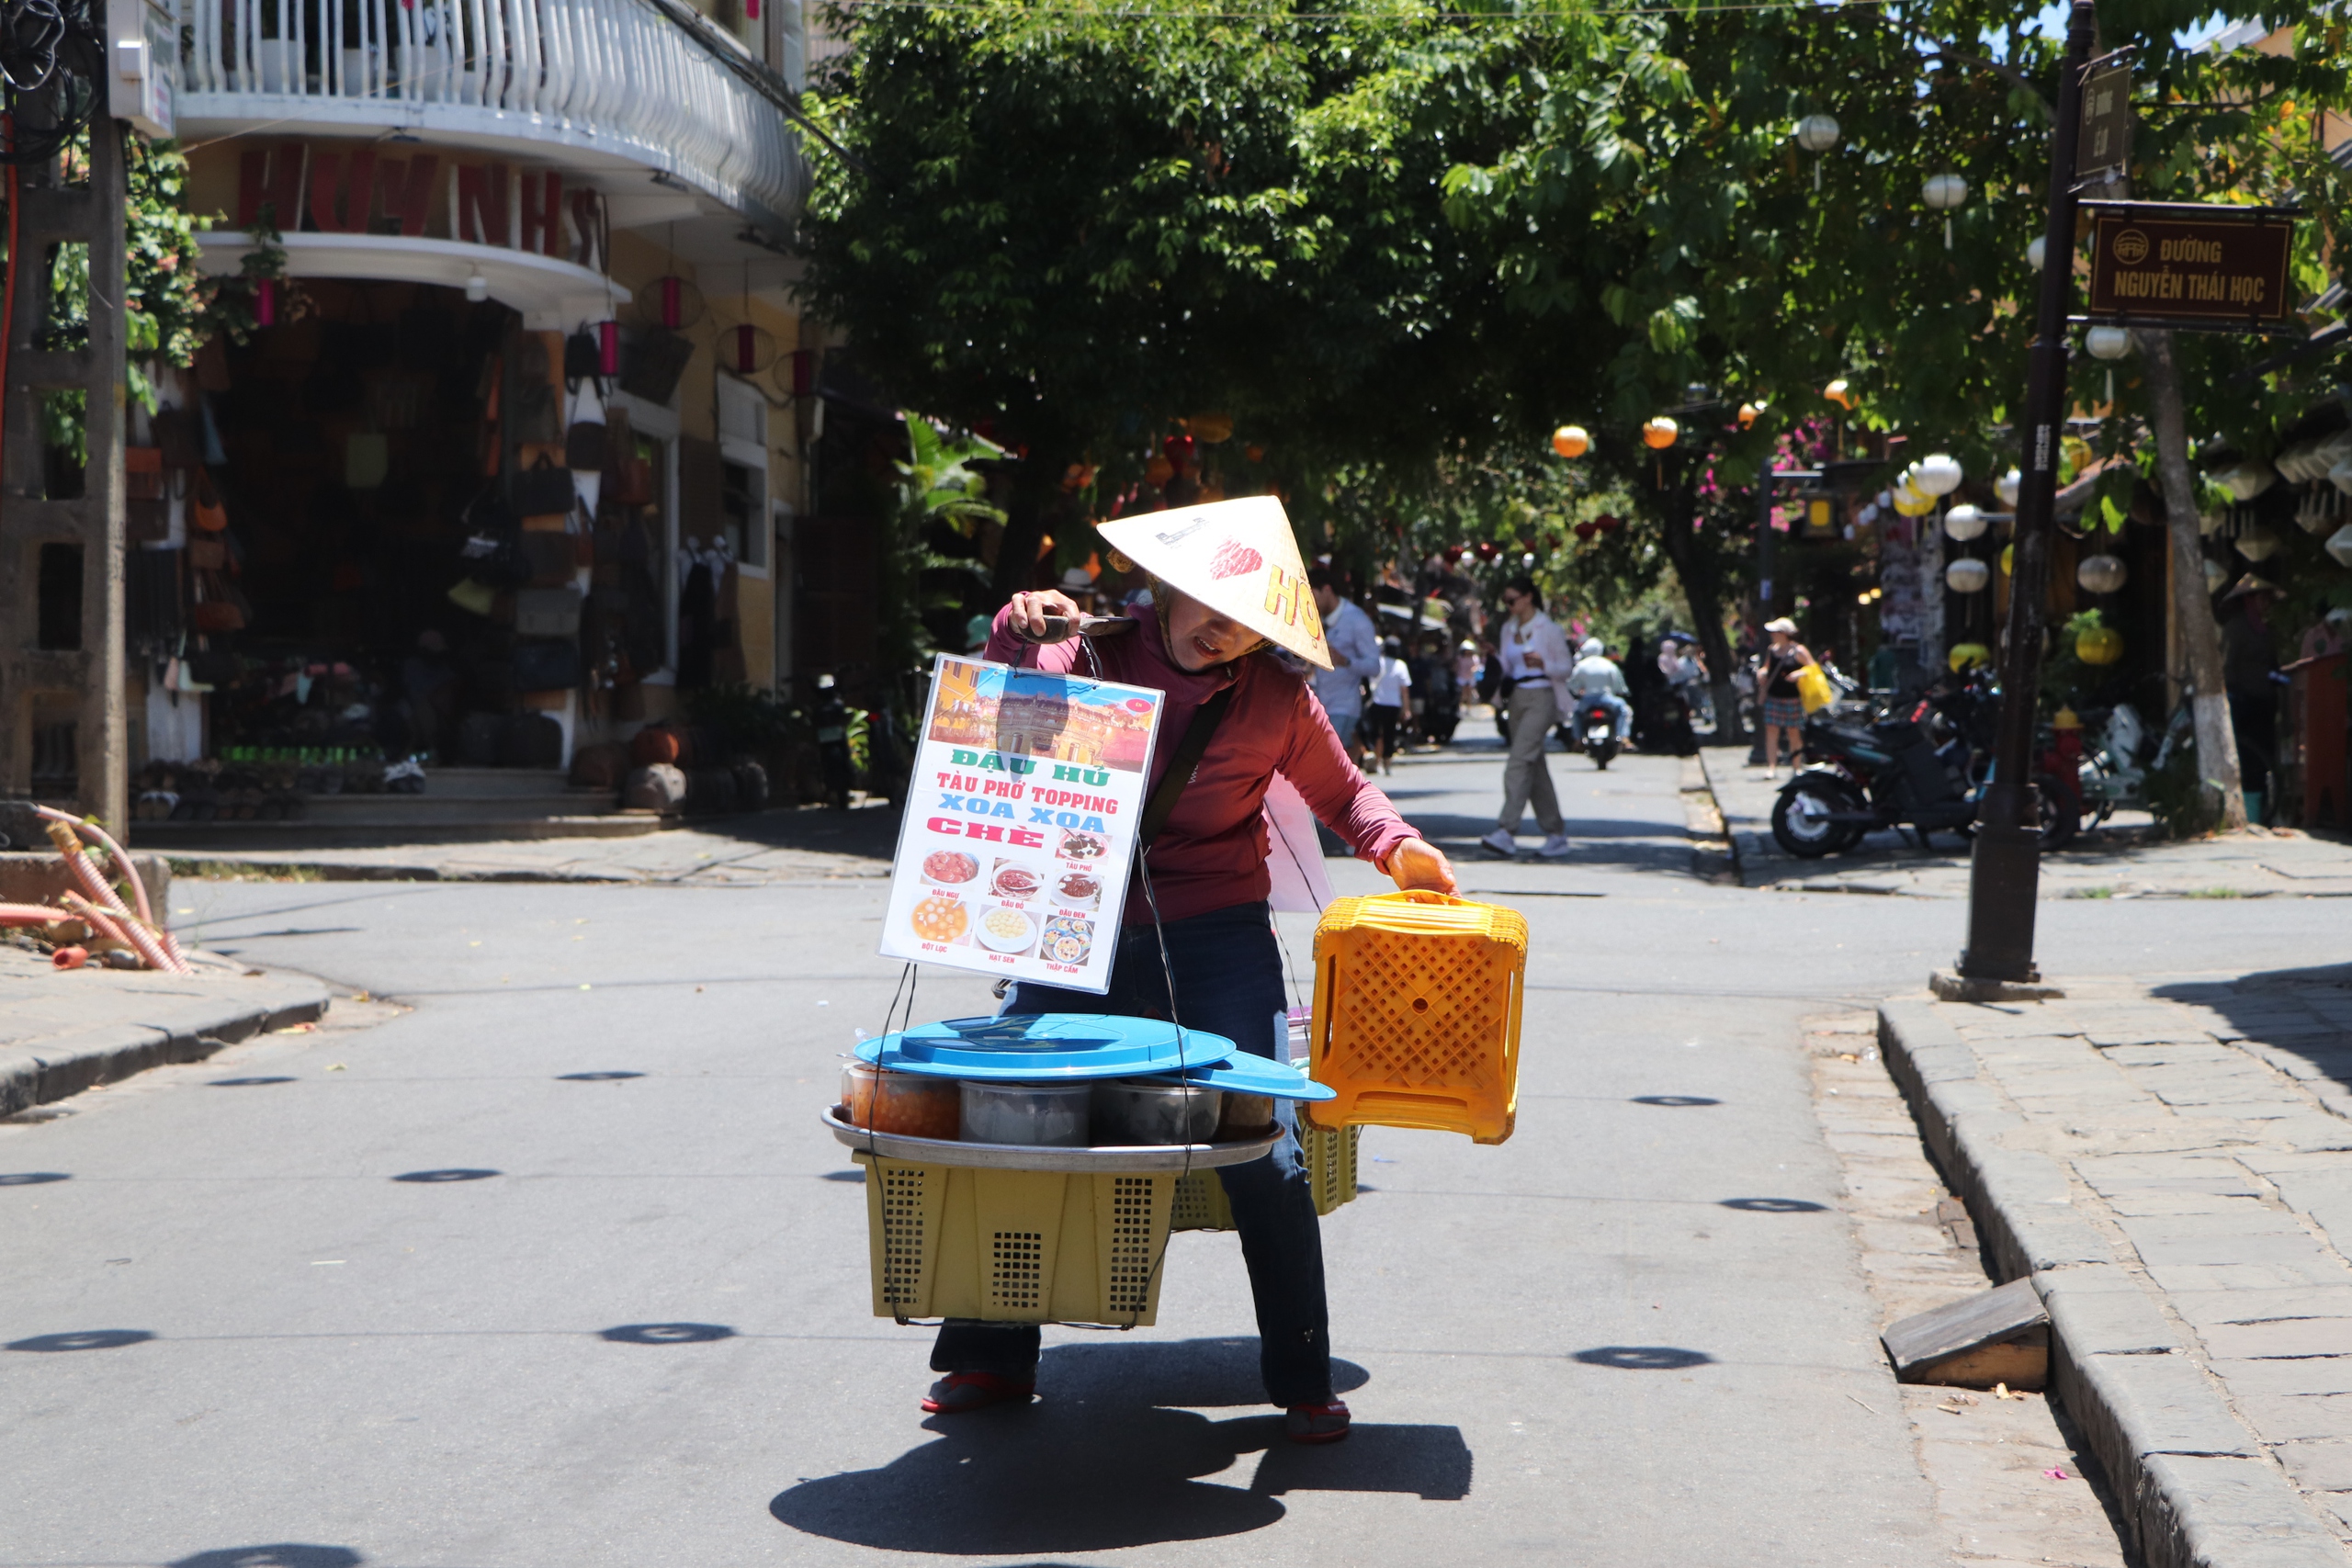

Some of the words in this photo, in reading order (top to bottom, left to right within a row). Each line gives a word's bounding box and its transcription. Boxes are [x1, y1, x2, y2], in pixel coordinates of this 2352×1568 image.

[2160, 234, 2222, 263] ĐƯỜNG
[2114, 265, 2183, 299] NGUYỄN
[2188, 271, 2225, 301] THÁI
[2230, 276, 2265, 307] HỌC
[950, 749, 1037, 775] ĐẬU
[1052, 765, 1111, 787] HỦ
[936, 770, 978, 793] TÀU
[982, 779, 1026, 800] PHỚ
[1031, 786, 1119, 815] TOPPING
[938, 793, 1015, 819] XOA
[1027, 807, 1105, 834] XOA
[926, 817, 1045, 849] CHÈ
[932, 888, 945, 897] ĐẬU
[1001, 899, 1014, 908] ĐẬU
[1014, 900, 1024, 909] ĐỎ
[1058, 908, 1072, 918] ĐẬU
[922, 942, 934, 951] BỘT
[934, 944, 947, 953] LỌC
[989, 953, 1001, 962] HẠT
[1002, 955, 1015, 964] SEN
[1046, 963, 1063, 972] THẬP
